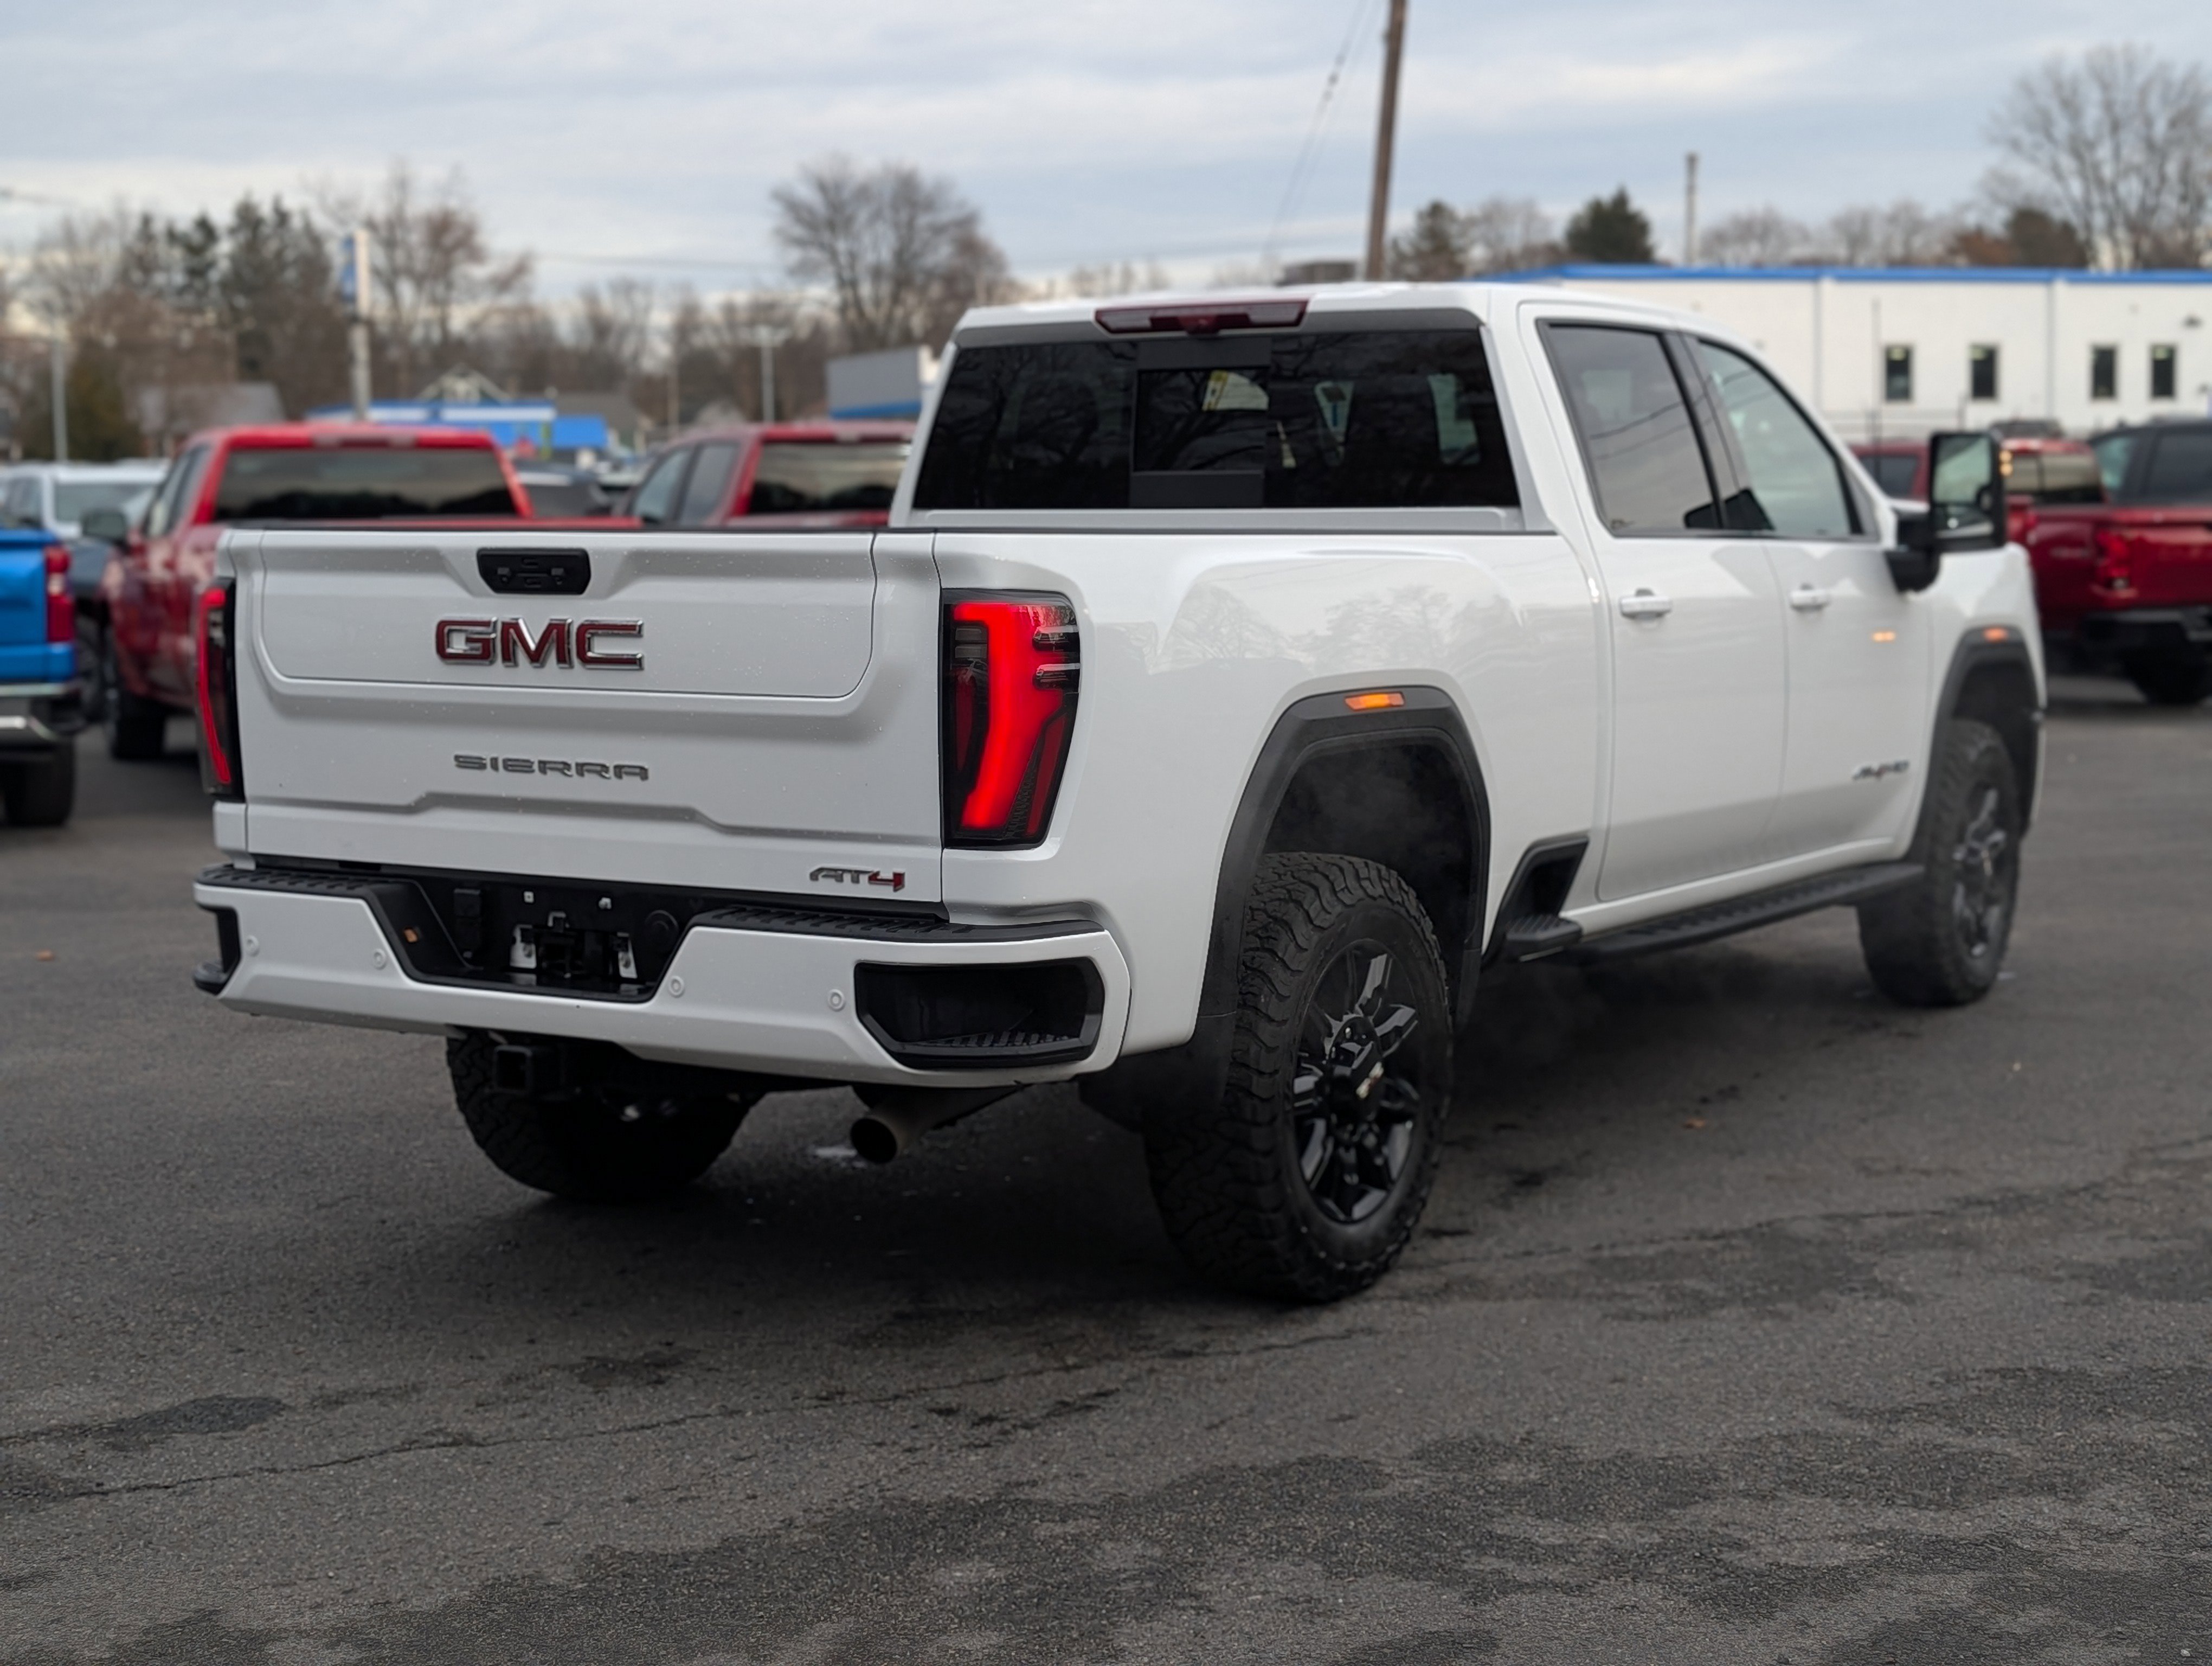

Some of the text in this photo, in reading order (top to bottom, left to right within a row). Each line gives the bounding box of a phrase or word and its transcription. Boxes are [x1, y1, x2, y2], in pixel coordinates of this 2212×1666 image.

[435, 617, 644, 670] GMC
[454, 754, 648, 781] SIERRA
[809, 867, 905, 892] AT4
